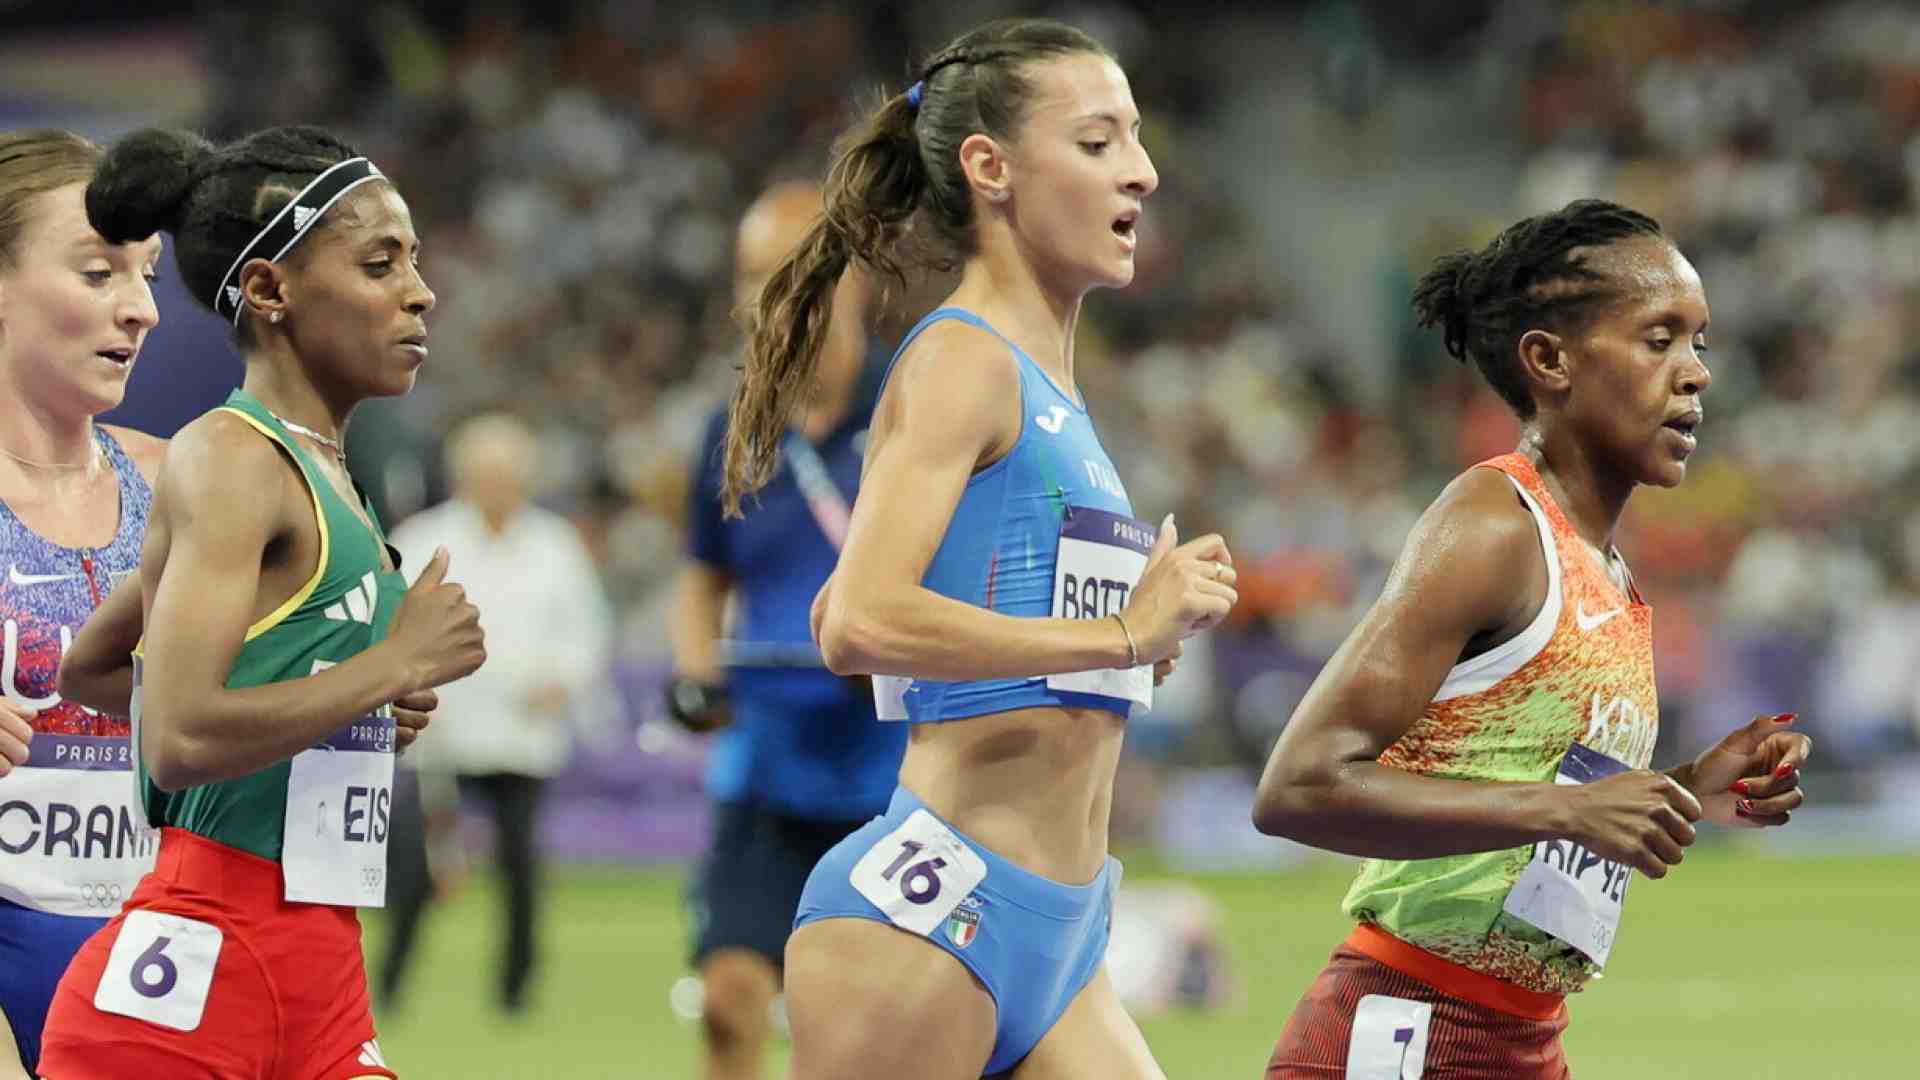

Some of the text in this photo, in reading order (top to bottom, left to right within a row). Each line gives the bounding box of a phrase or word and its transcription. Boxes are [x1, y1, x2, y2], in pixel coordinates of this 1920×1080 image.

[1062, 573, 1133, 619] BATT
[55, 744, 134, 762] PARIS 2
[351, 725, 386, 744] PARIS
[881, 840, 948, 905] 16
[130, 935, 177, 998] 6
